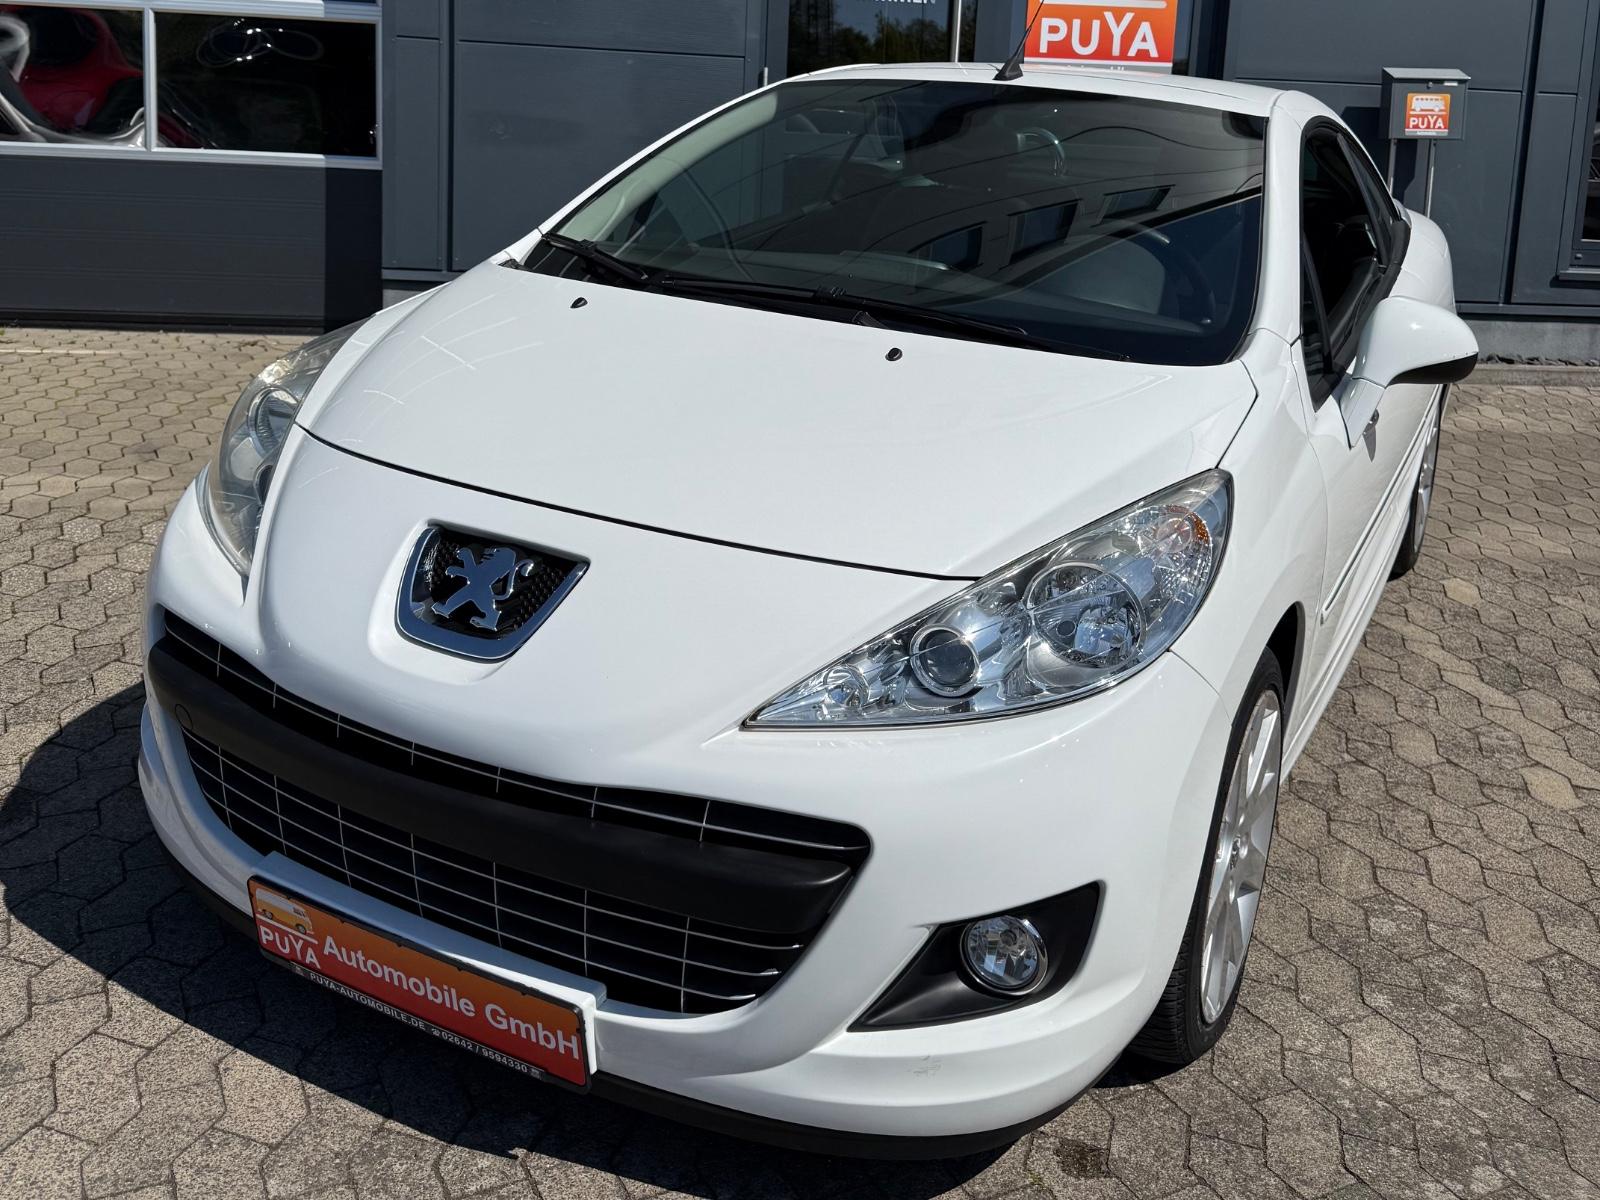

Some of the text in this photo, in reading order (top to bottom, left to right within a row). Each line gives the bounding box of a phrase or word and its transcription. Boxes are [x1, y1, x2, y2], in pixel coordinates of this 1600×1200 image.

[1039, 11, 1159, 57] PUYA
[1409, 115, 1444, 129] PUYA
[260, 925, 321, 969] PUYA
[323, 936, 580, 1060] Automobile GmbH
[310, 973, 426, 1031] PUYA-AUTOMOBILE.DE
[442, 1032, 473, 1051] 02642
[482, 1048, 528, 1073] 9594330
